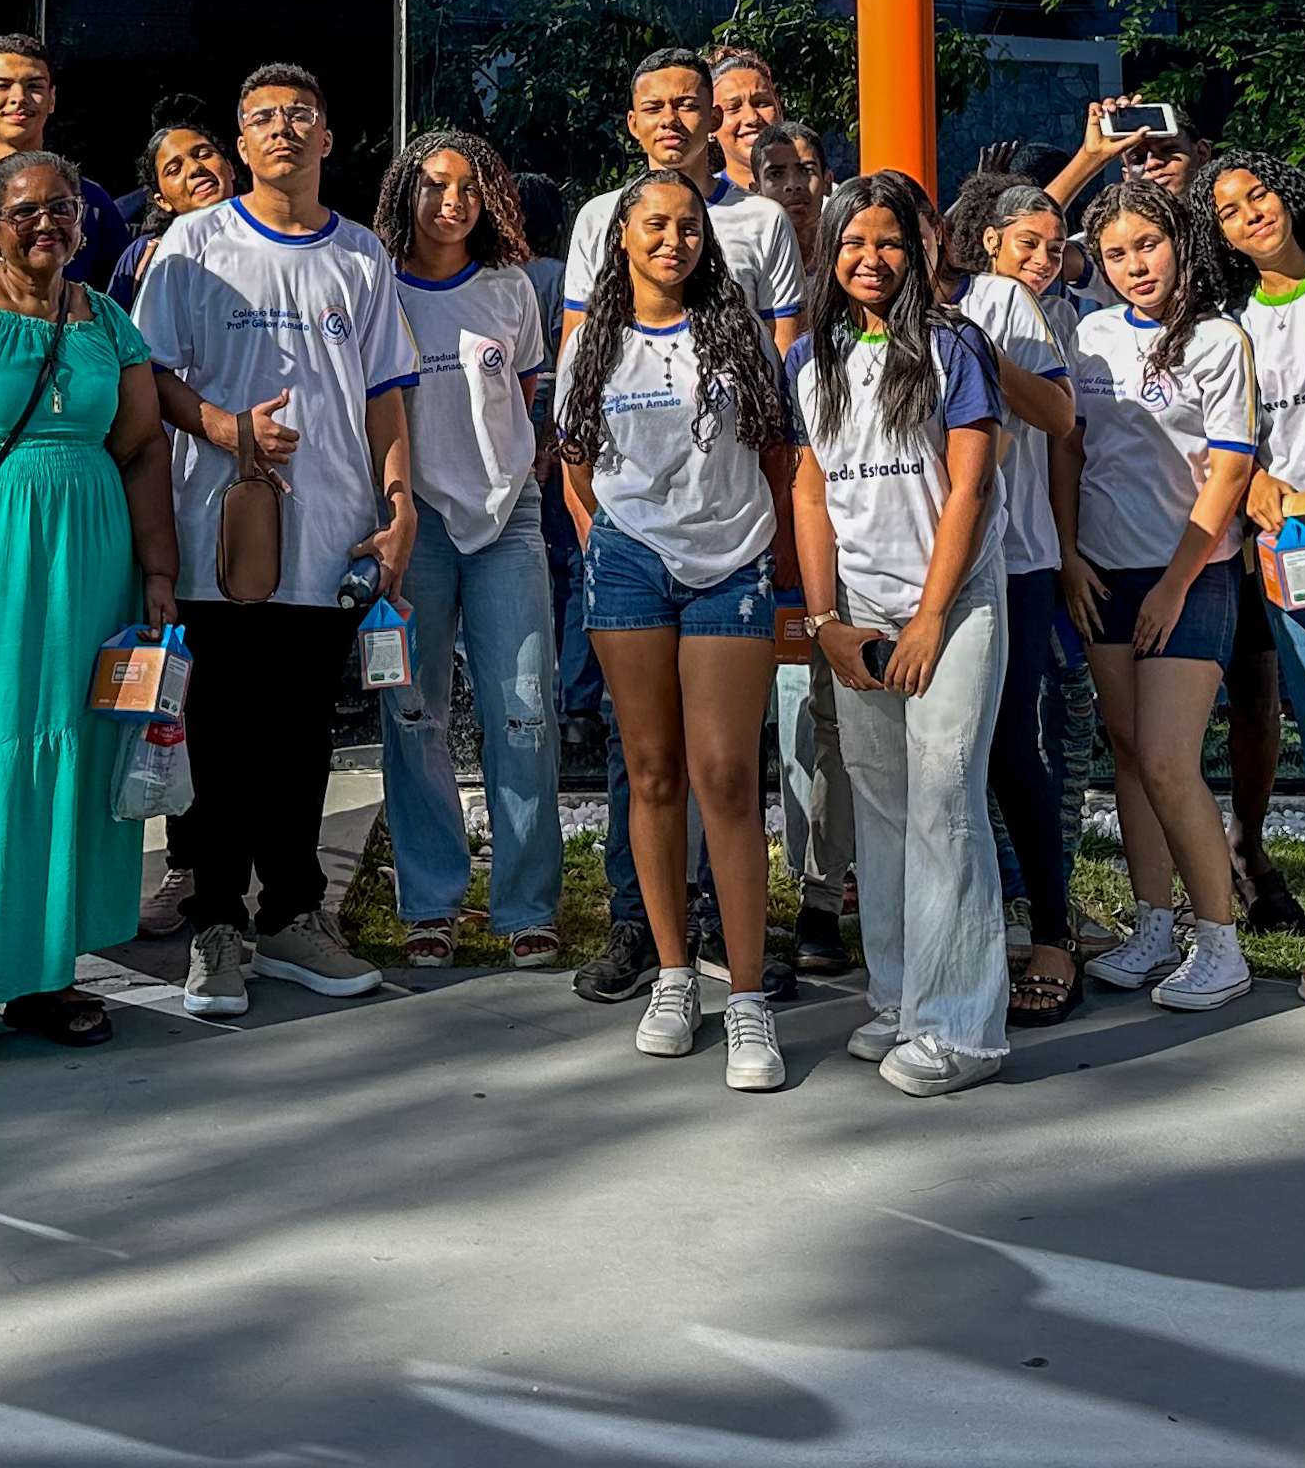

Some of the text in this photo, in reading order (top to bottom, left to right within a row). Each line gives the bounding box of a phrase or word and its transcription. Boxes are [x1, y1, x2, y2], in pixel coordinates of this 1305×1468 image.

[422, 351, 459, 364] Estadual
[646, 397, 682, 409] Amado
[859, 456, 925, 479] Estadual
